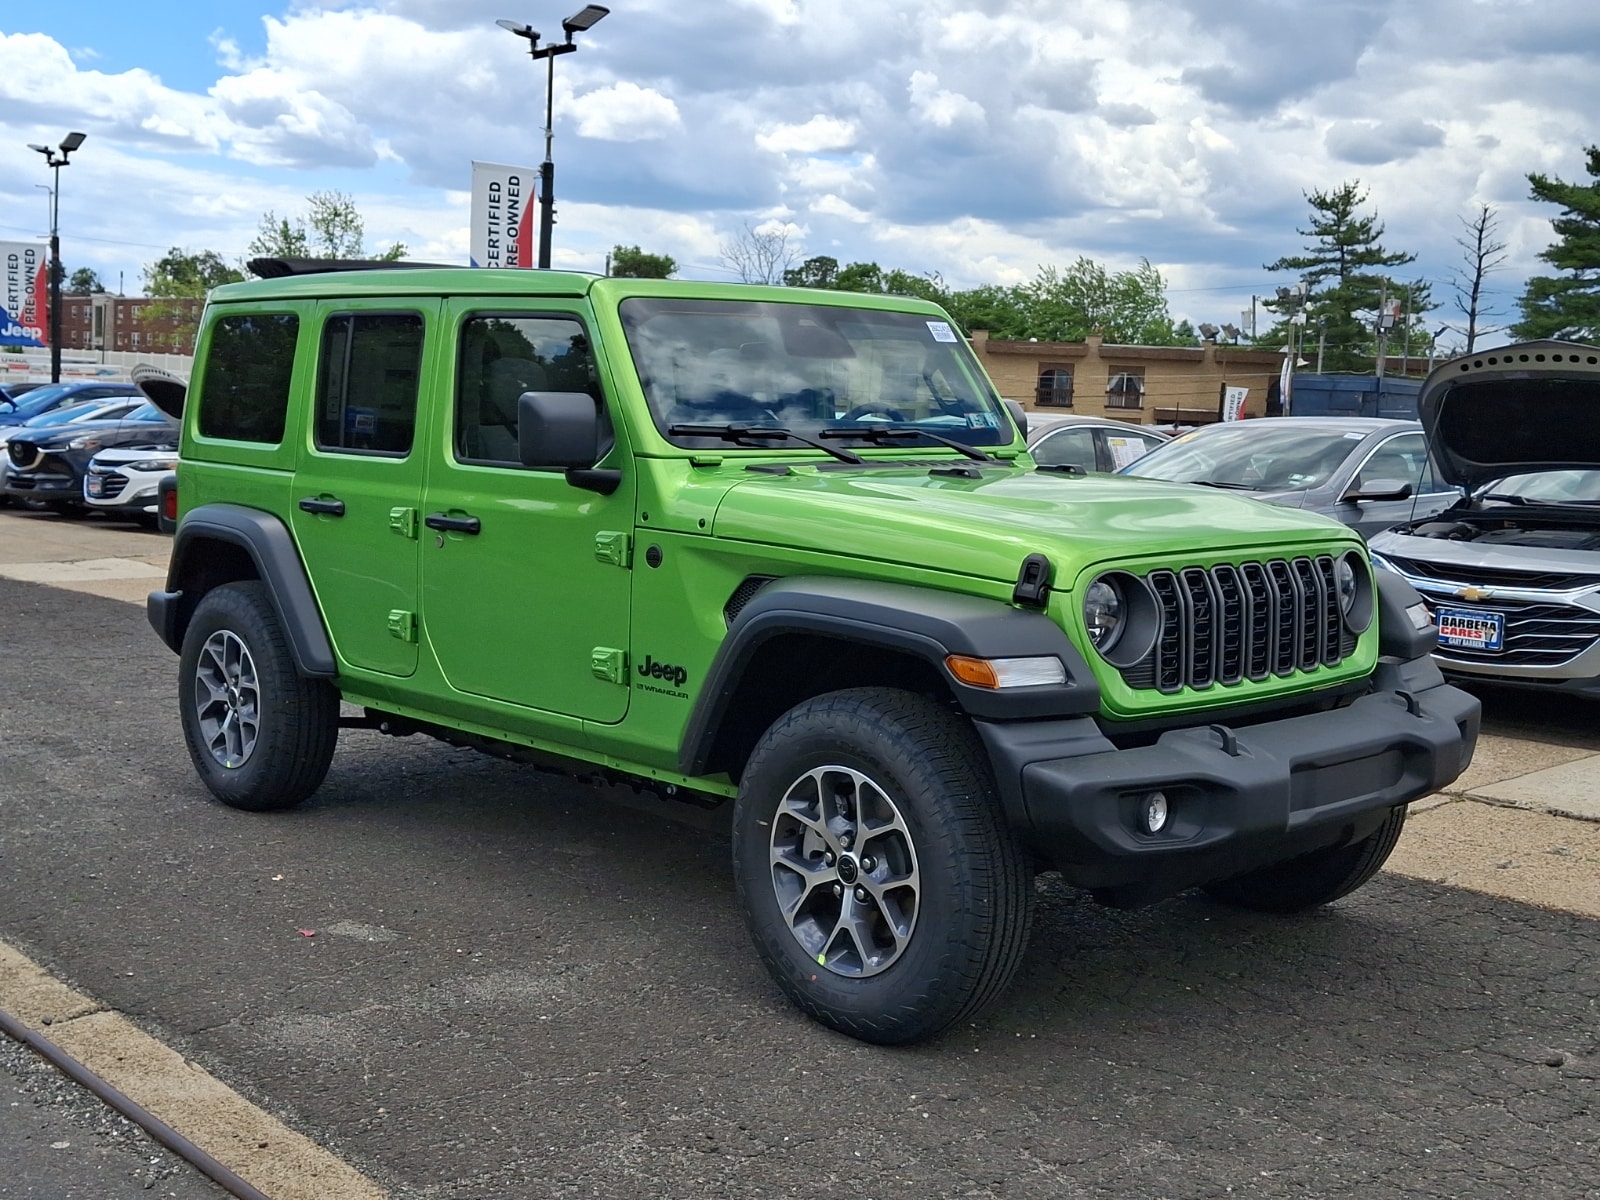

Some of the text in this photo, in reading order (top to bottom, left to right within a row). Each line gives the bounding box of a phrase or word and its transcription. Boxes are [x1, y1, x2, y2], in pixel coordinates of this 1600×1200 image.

[507, 175, 520, 266] RE-OWNED
[8, 253, 19, 320] CERTIFIED
[25, 248, 36, 323] PRE-OWNED
[1, 322, 43, 340] Jeep
[1440, 626, 1483, 639] CARES
[1441, 617, 1497, 632] BARBERA
[1448, 637, 1486, 648] GARY BARBERA
[638, 654, 688, 688] Jeep
[644, 685, 689, 699] WRANGLER
